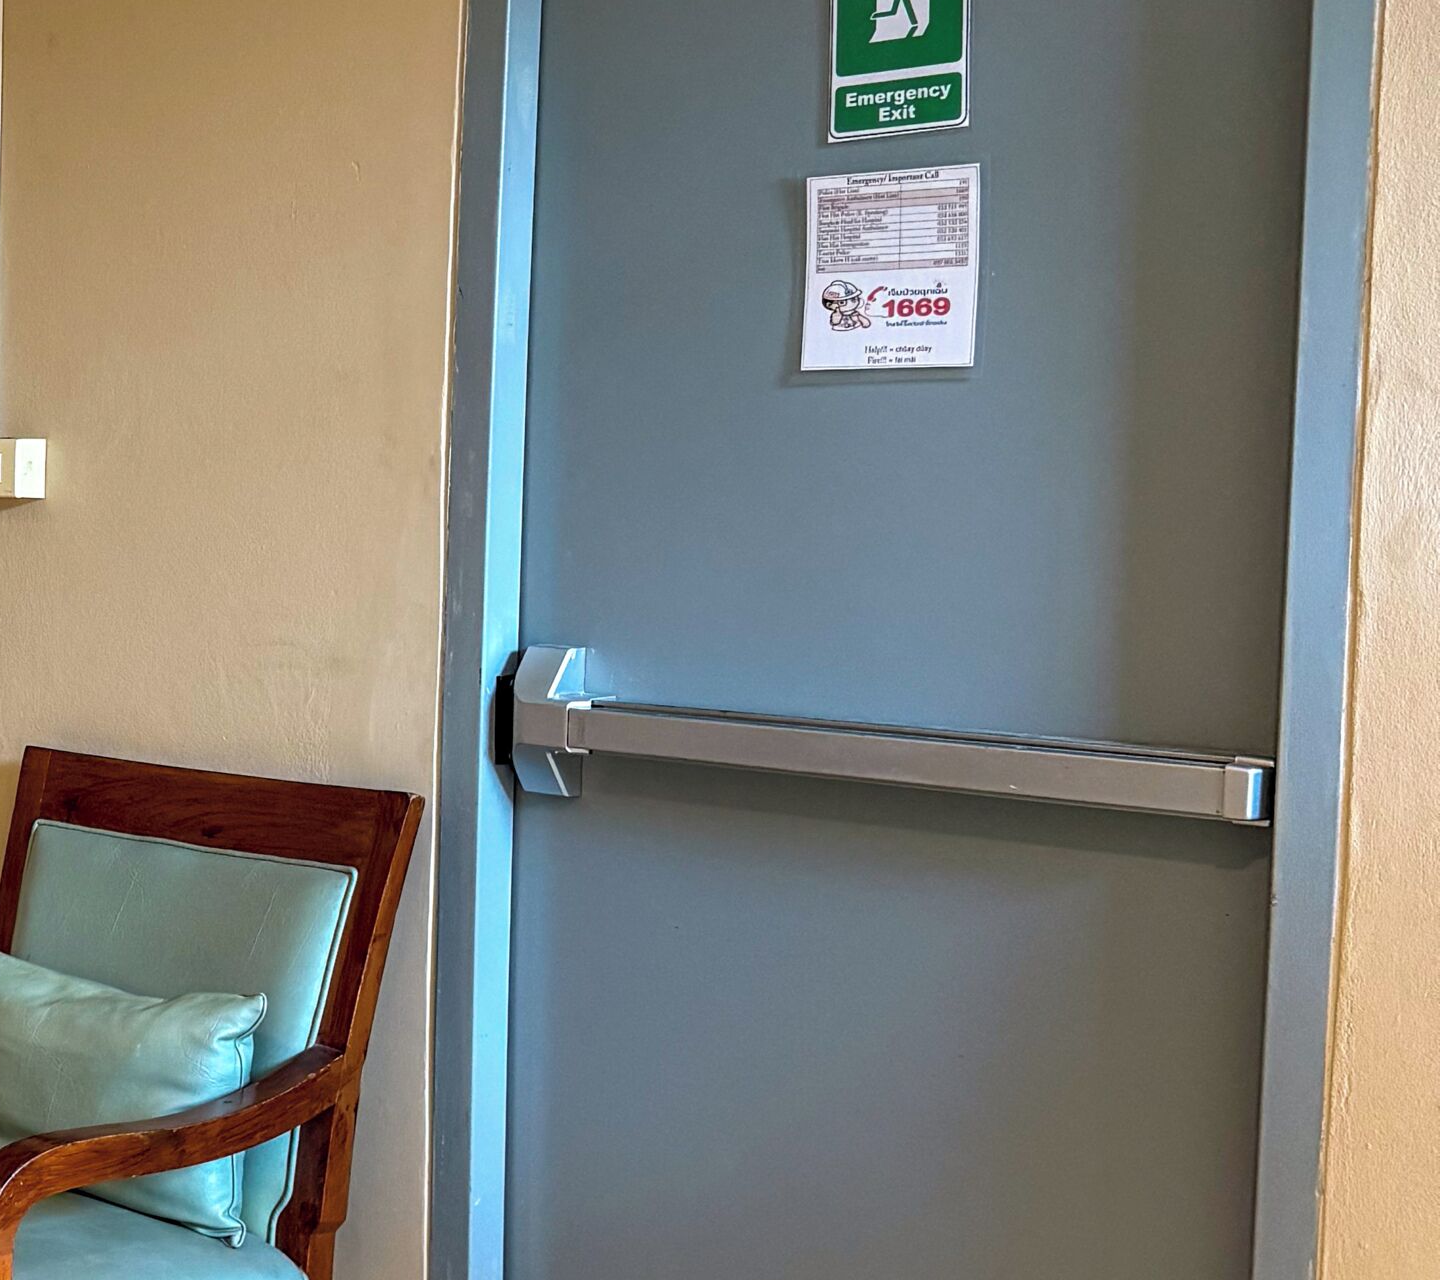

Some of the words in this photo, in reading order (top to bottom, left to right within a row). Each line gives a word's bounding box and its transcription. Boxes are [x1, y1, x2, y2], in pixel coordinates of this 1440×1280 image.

[845, 84, 951, 107] Emergency
[879, 105, 916, 122] Exit
[888, 173, 923, 183] Important
[924, 170, 939, 179] Call
[882, 297, 951, 318] 1669
